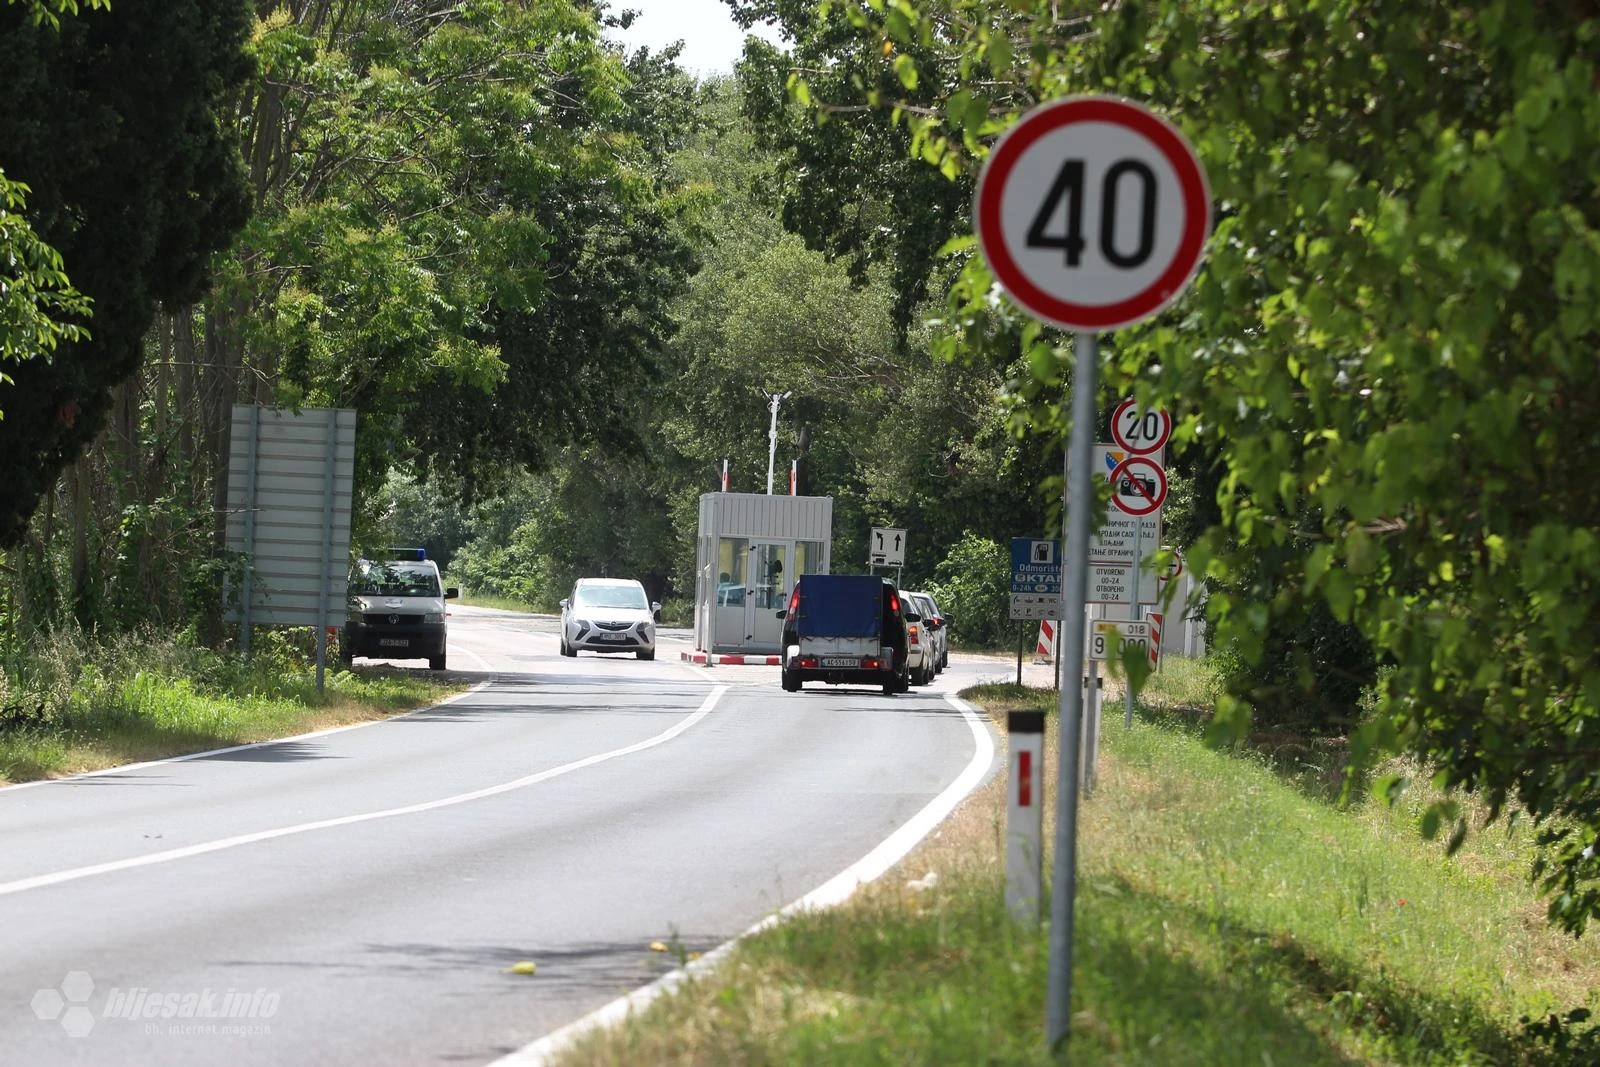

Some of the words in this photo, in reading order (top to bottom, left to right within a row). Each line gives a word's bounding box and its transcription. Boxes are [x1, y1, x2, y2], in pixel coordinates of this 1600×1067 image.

[1025, 158, 1158, 270] 40
[1126, 410, 1158, 441] 20
[1095, 568, 1125, 576] OTVORENO
[1100, 593, 1119, 601] 00-24
[1128, 624, 1146, 635] 018
